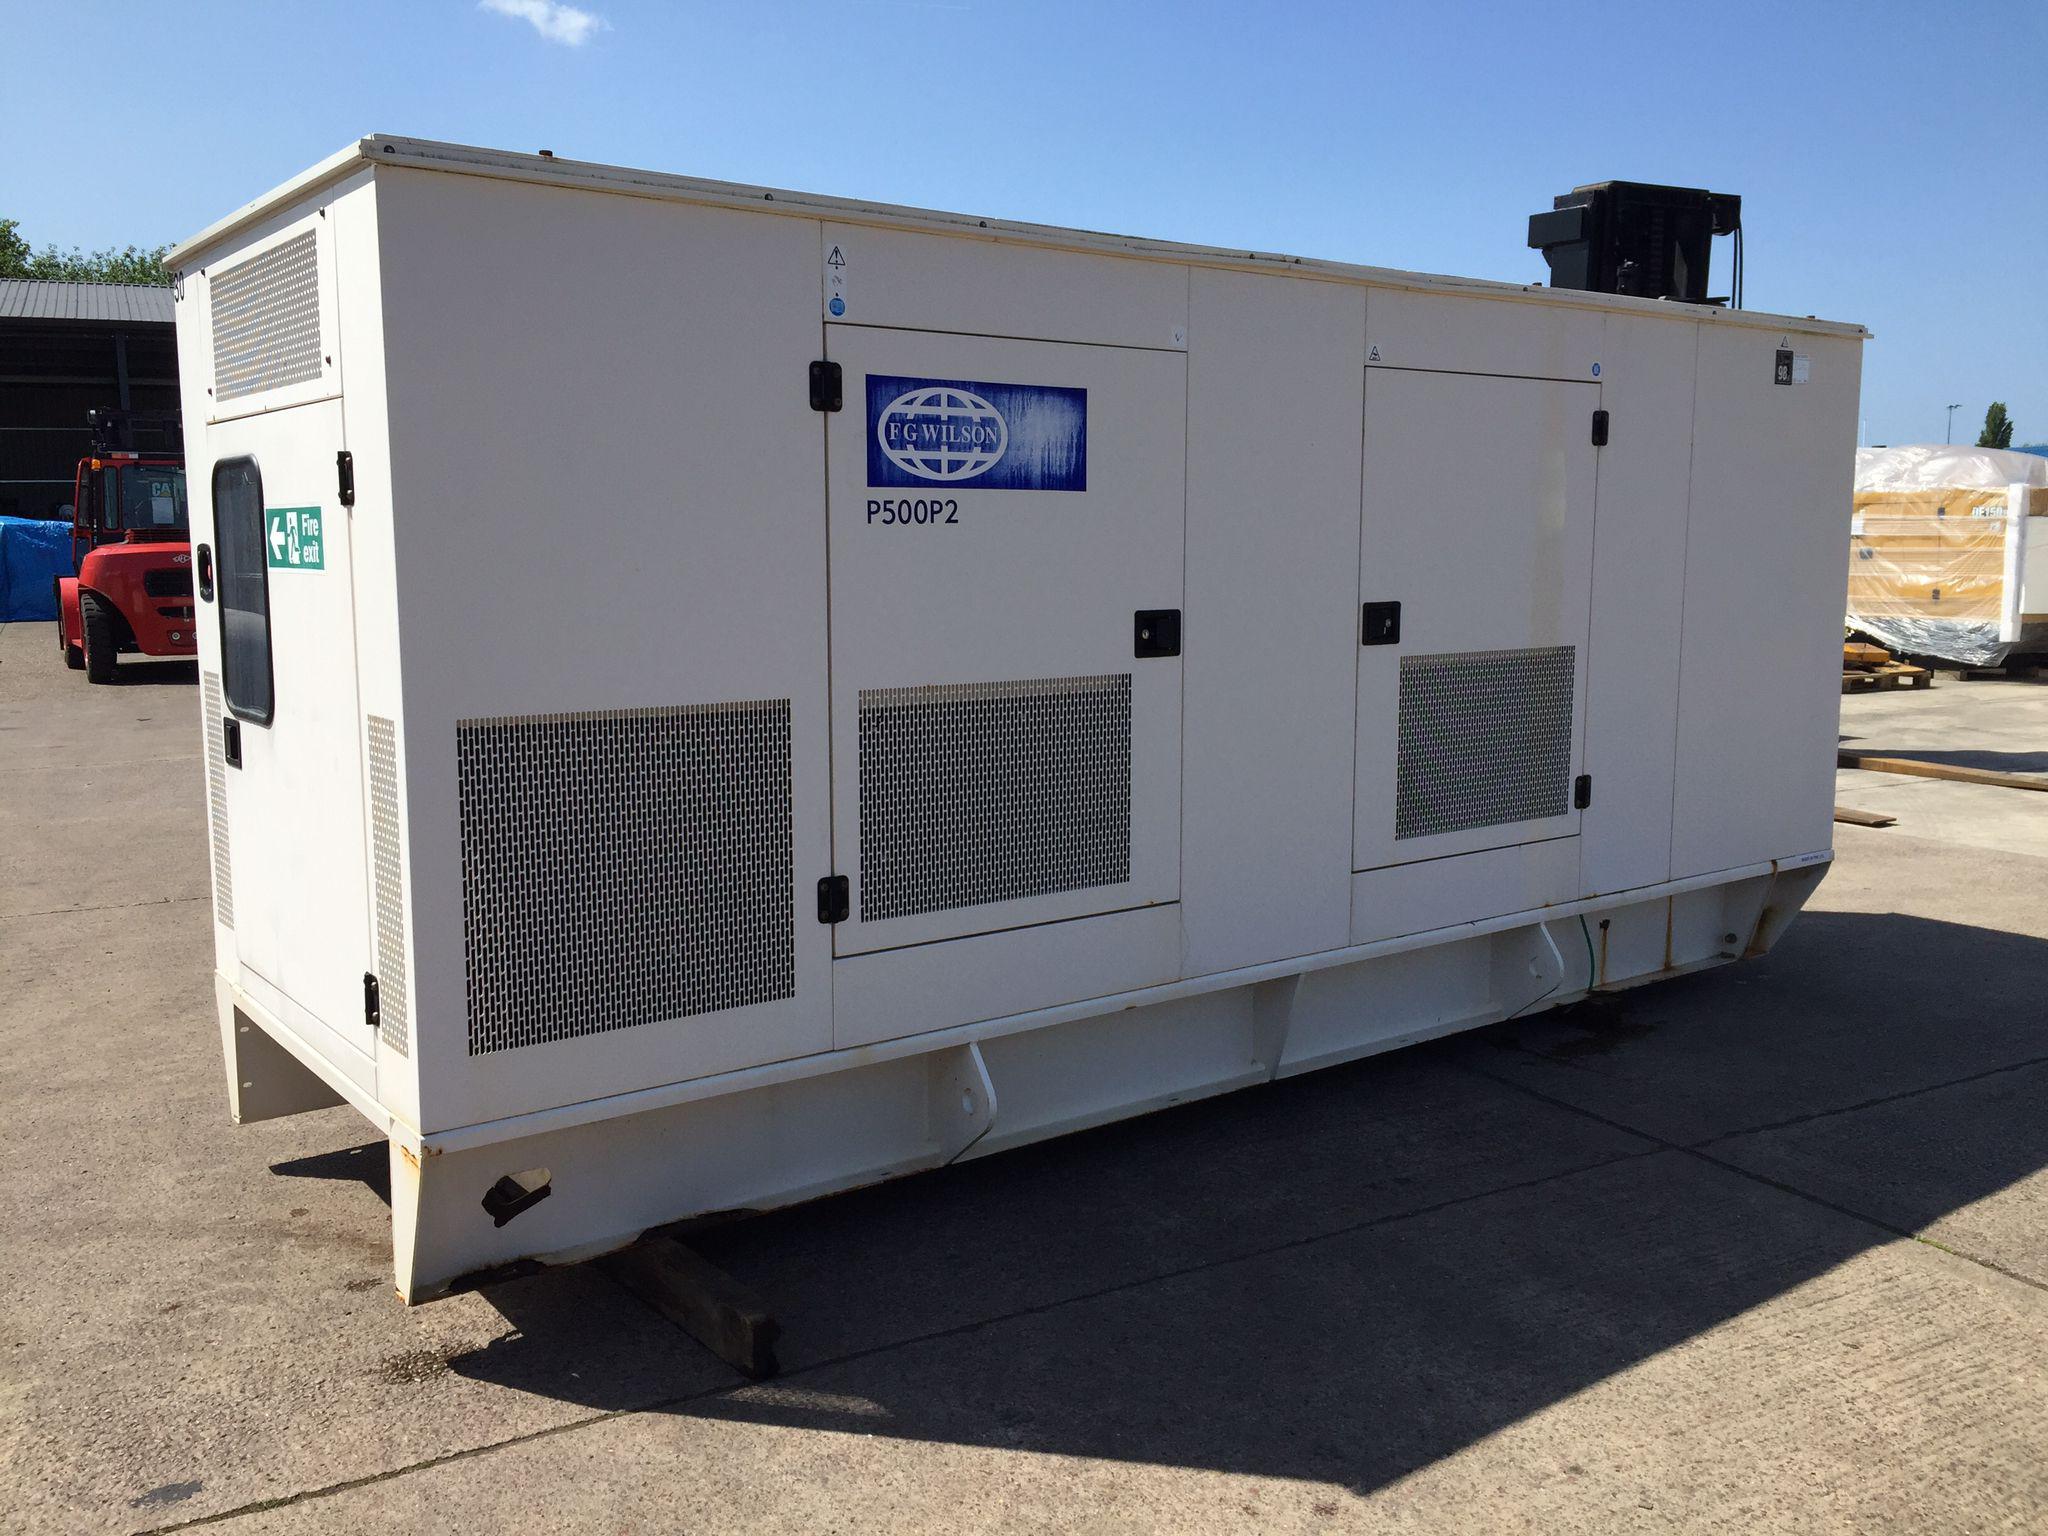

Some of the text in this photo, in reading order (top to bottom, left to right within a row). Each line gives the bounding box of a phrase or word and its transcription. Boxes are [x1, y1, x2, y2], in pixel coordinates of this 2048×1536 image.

[921, 422, 998, 444] WILSON
[867, 499, 958, 525] P500P2
[301, 513, 319, 537] Fire
[303, 540, 320, 563] exit
